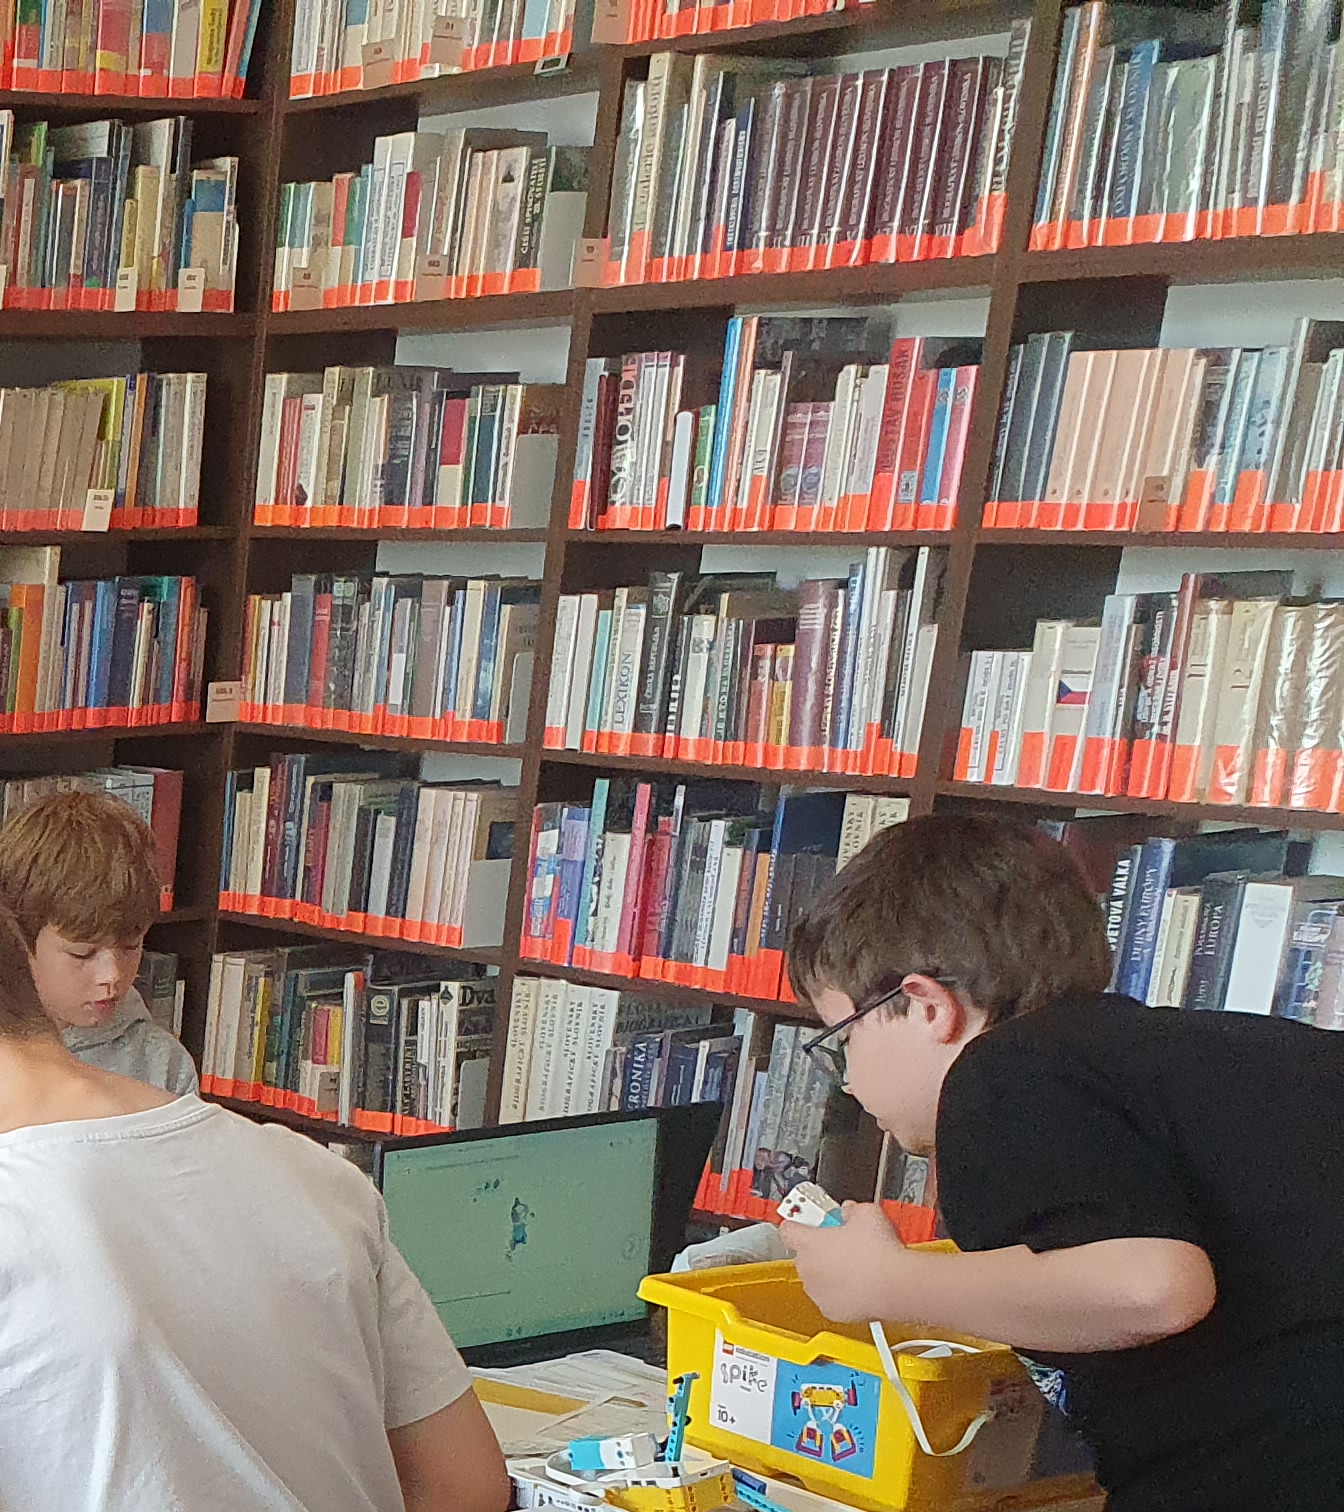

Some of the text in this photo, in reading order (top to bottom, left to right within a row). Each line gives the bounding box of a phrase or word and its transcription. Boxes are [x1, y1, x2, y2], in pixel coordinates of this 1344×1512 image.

[613, 652, 632, 725] LEXIKON
[1111, 858, 1132, 897] VÁLKA
[719, 1361, 769, 1394] spike
